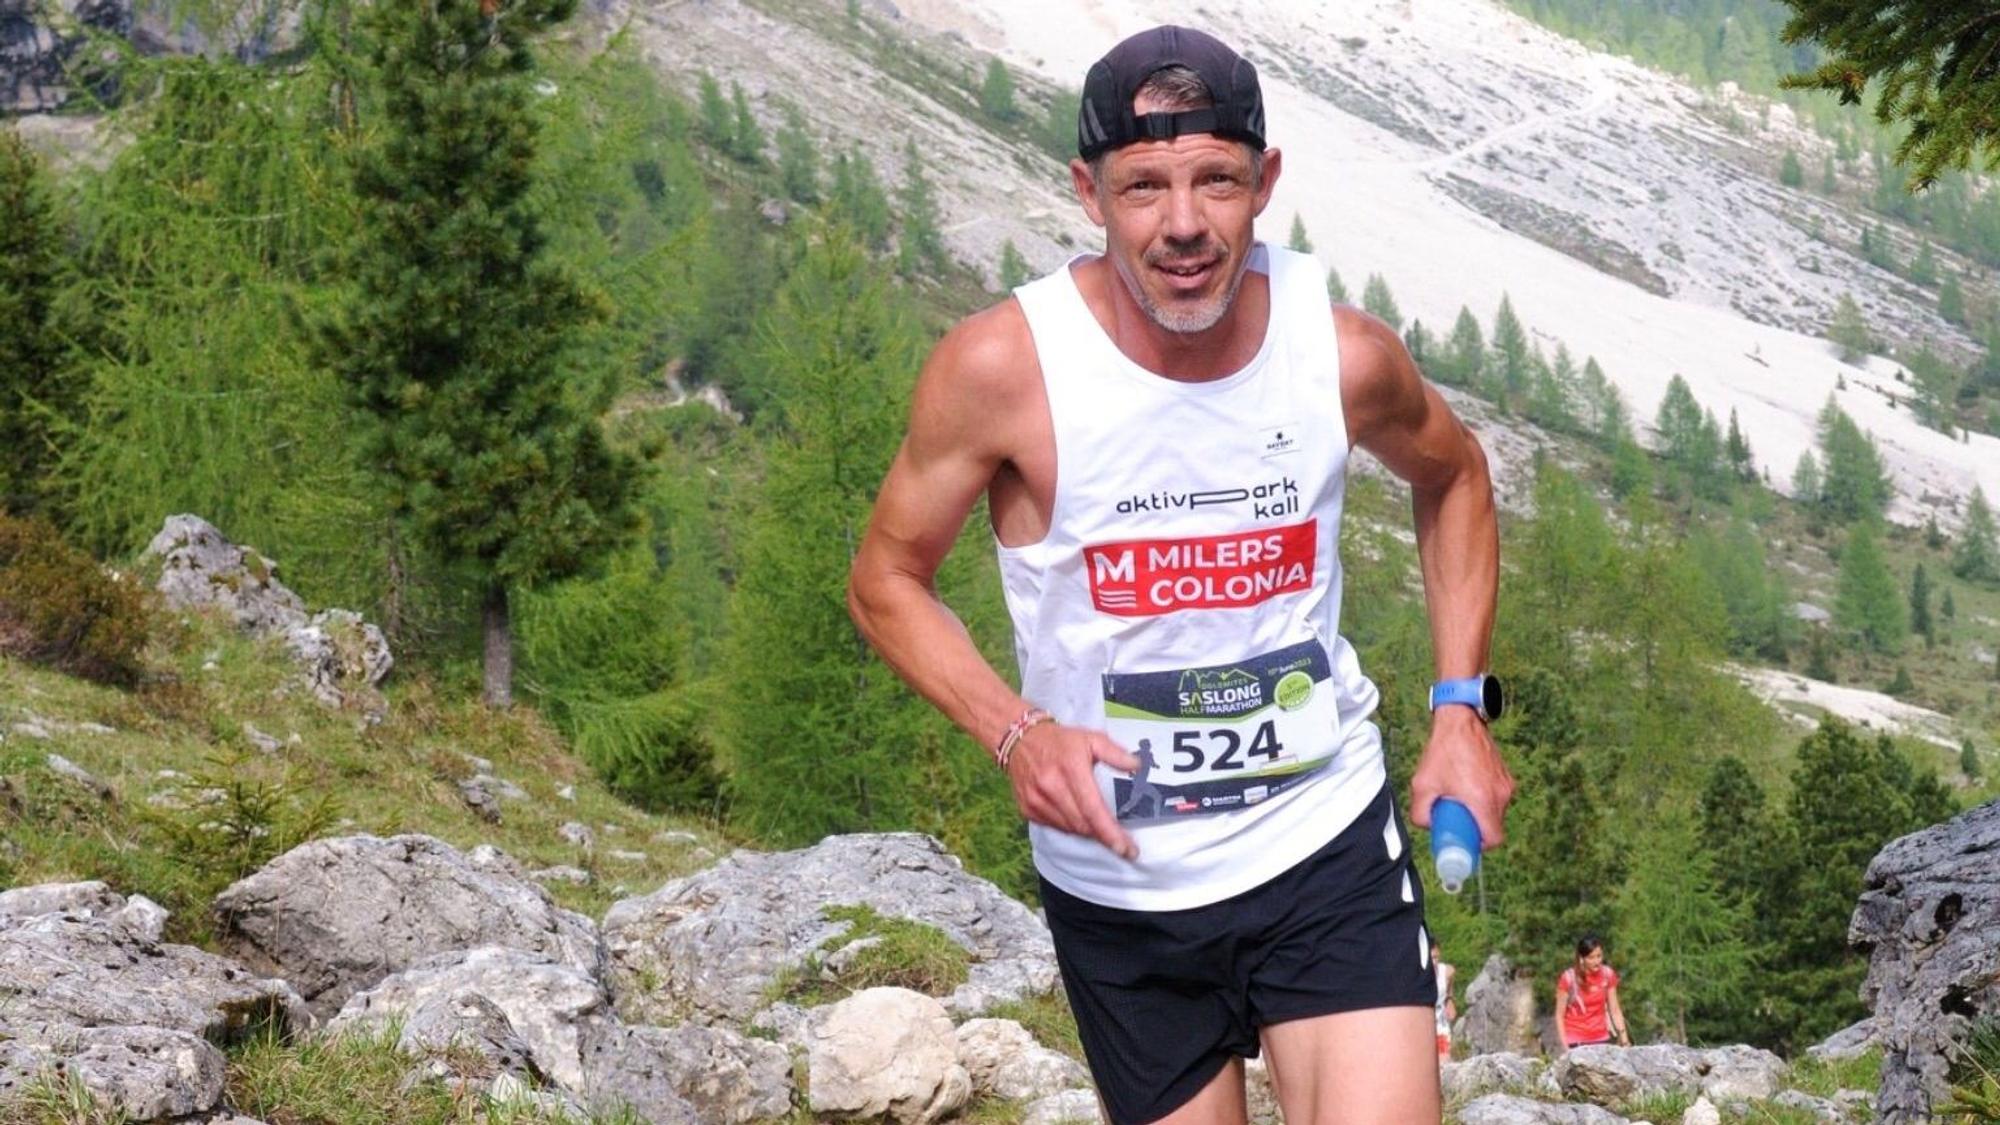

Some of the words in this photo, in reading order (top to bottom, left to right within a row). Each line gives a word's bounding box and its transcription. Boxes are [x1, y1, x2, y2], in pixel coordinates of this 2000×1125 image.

[1254, 496, 1299, 519] kall
[1149, 535, 1283, 572] MILERS
[1150, 563, 1307, 607] COLONIA
[1179, 682, 1261, 706] SASLONG
[1172, 719, 1283, 773] 524
